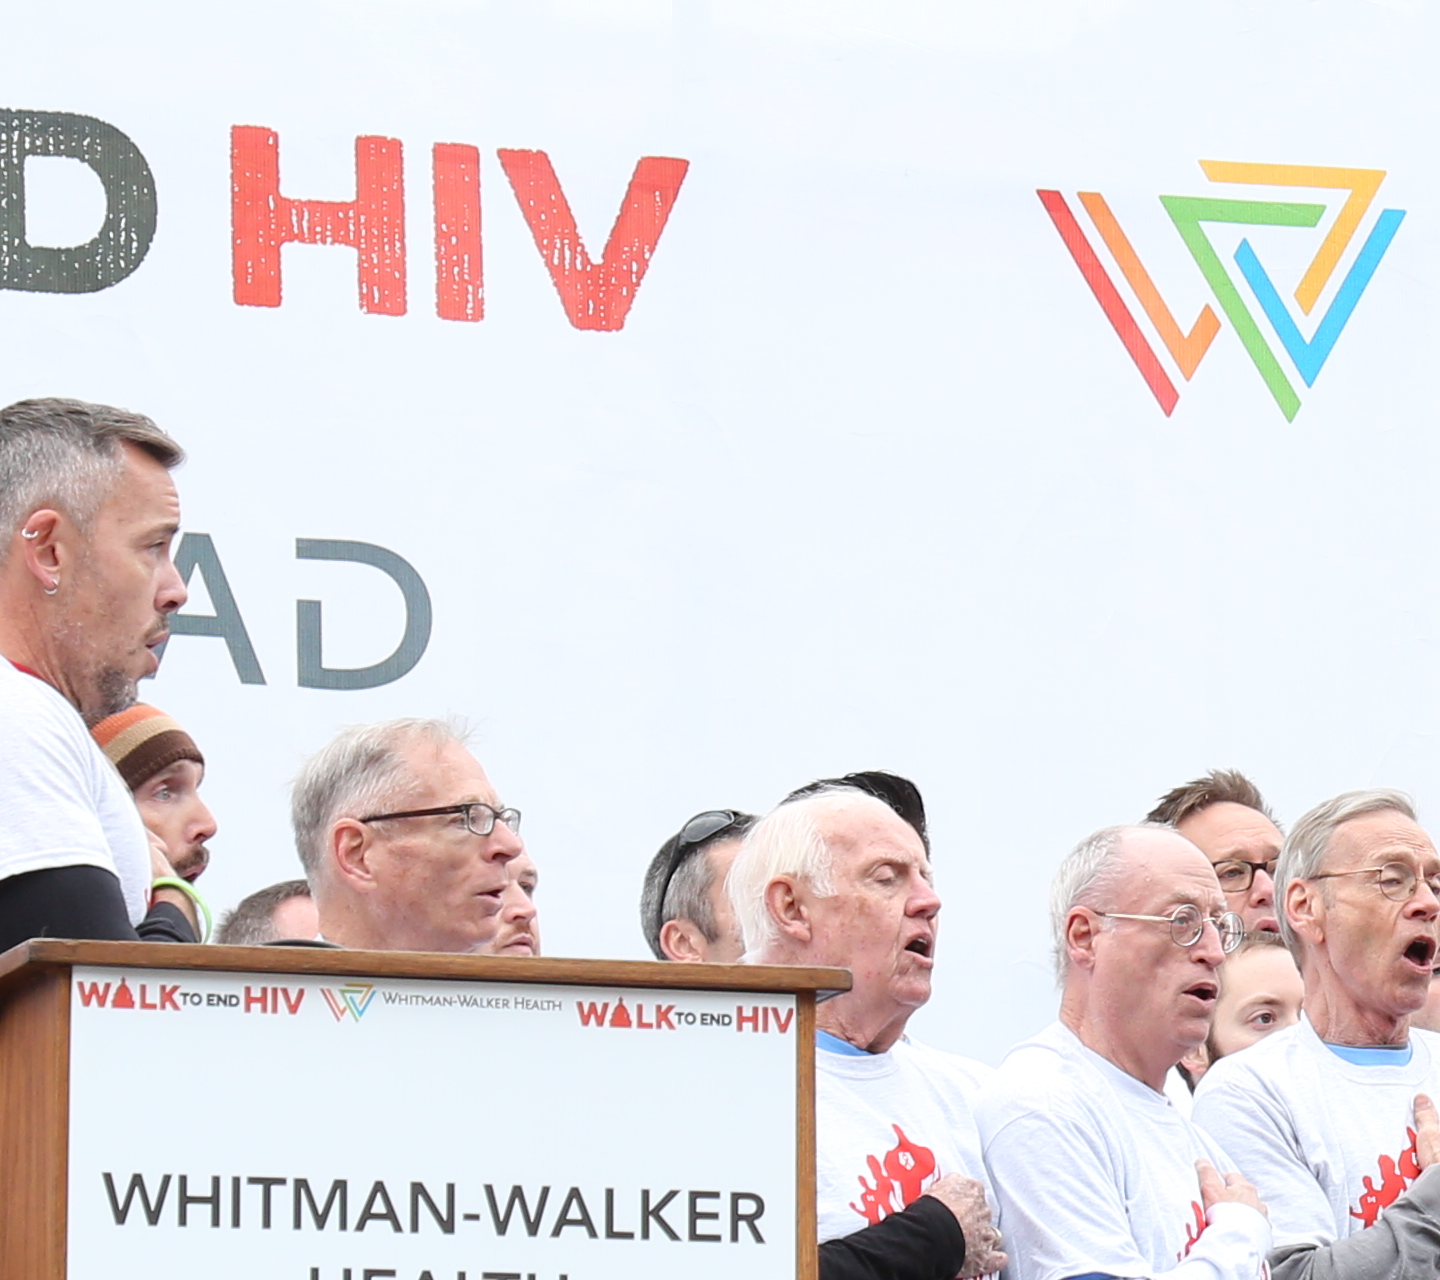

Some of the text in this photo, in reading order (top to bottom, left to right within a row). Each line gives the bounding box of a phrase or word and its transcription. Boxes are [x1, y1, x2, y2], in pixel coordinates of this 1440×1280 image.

[230, 124, 690, 332] HIV
[180, 992, 203, 1007] TO
[206, 994, 240, 1008] END
[244, 985, 305, 1015] HIV
[382, 991, 563, 1012] WHITMAN-WALKER HEALTH
[675, 1011, 696, 1026] TO
[701, 1012, 732, 1027] END
[736, 1005, 794, 1034] HIV
[102, 1172, 767, 1244] WHITMAN-WALKER
